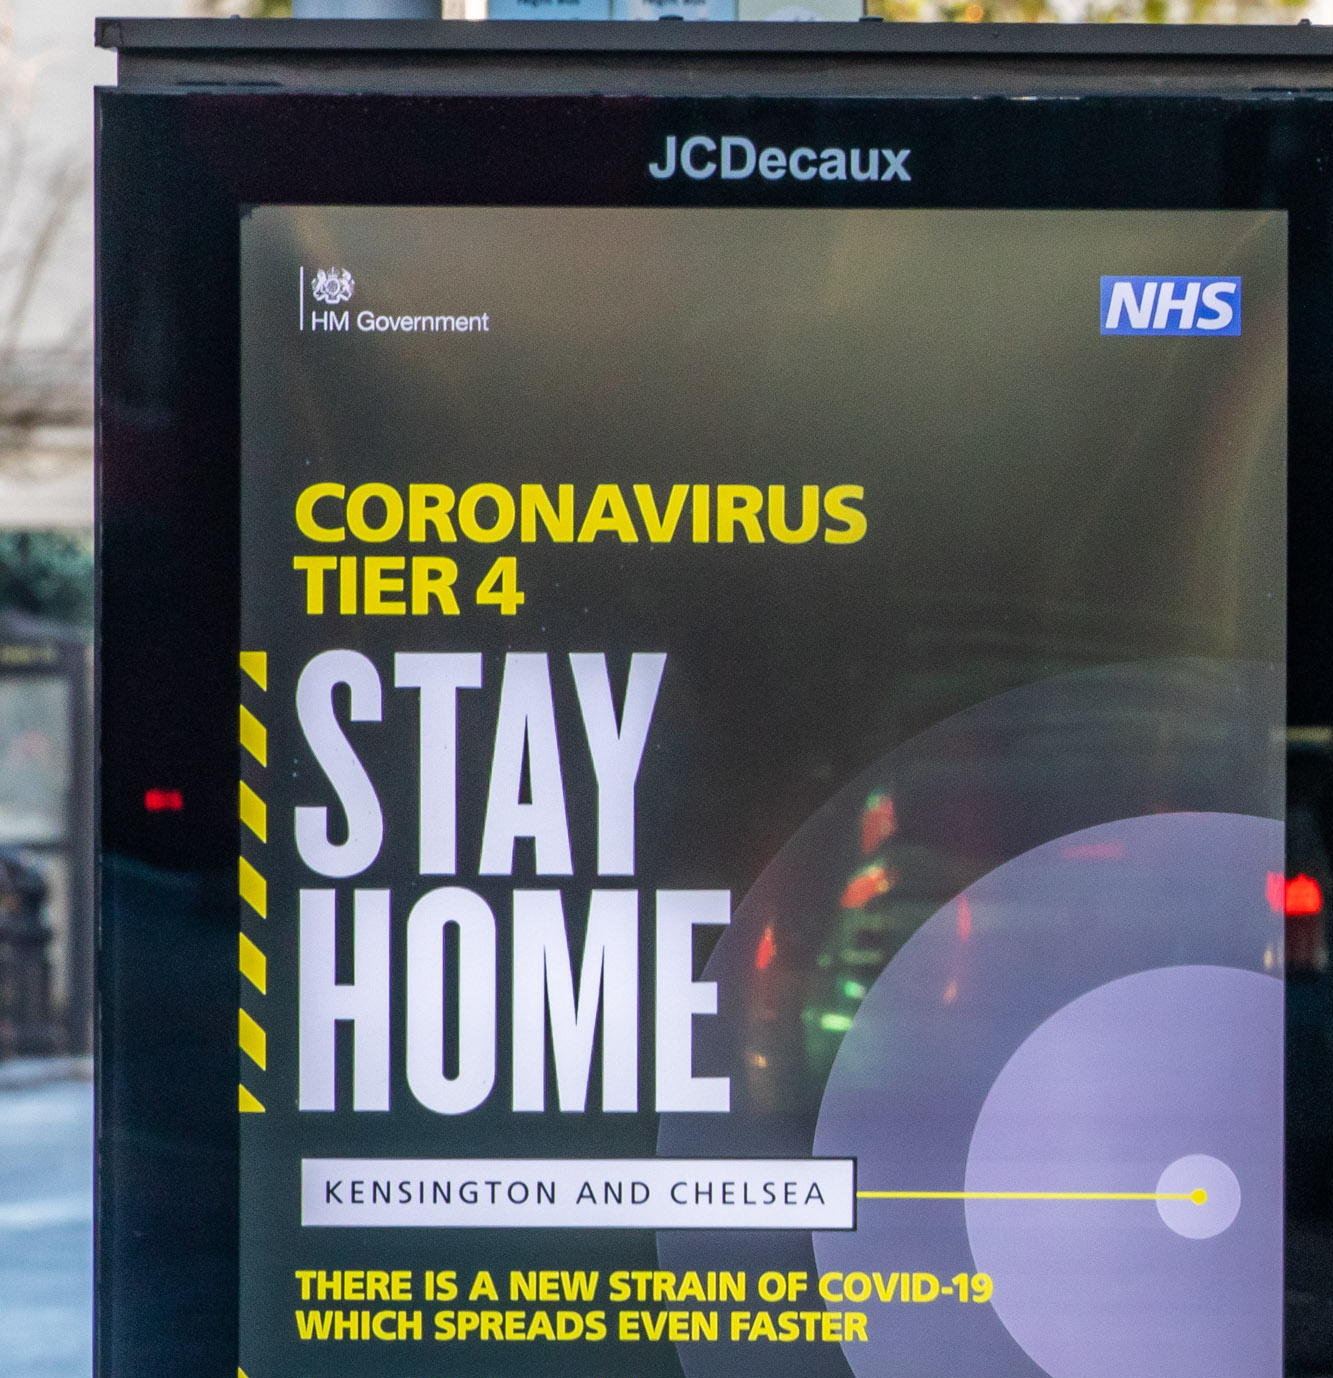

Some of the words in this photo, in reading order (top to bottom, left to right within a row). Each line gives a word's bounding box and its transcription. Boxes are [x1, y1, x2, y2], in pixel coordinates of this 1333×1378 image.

[649, 136, 911, 181] JCDecaux
[312, 311, 349, 331] HM
[357, 311, 489, 331] Government
[1106, 282, 1236, 329] NHS
[296, 483, 866, 543] CORONAVIRUS
[293, 556, 460, 615] TIER
[476, 557, 524, 615] 4
[295, 649, 667, 878] STAY
[299, 887, 731, 1115] HOME
[326, 1181, 557, 1204] KENSINGTON
[576, 1182, 650, 1204] AND
[671, 1182, 826, 1204] CHELSEA
[295, 1271, 412, 1300] THERE
[425, 1271, 457, 1301] IS
[469, 1271, 498, 1300] A
[510, 1271, 598, 1301] NEW
[610, 1271, 745, 1301] STRAIN
[758, 1272, 807, 1302] OF
[819, 1272, 993, 1303] COVID-19
[296, 1310, 422, 1340] WHICH
[435, 1311, 606, 1340] SPREADS
[619, 1311, 718, 1341] EVEN
[731, 1311, 867, 1341] FASTER
